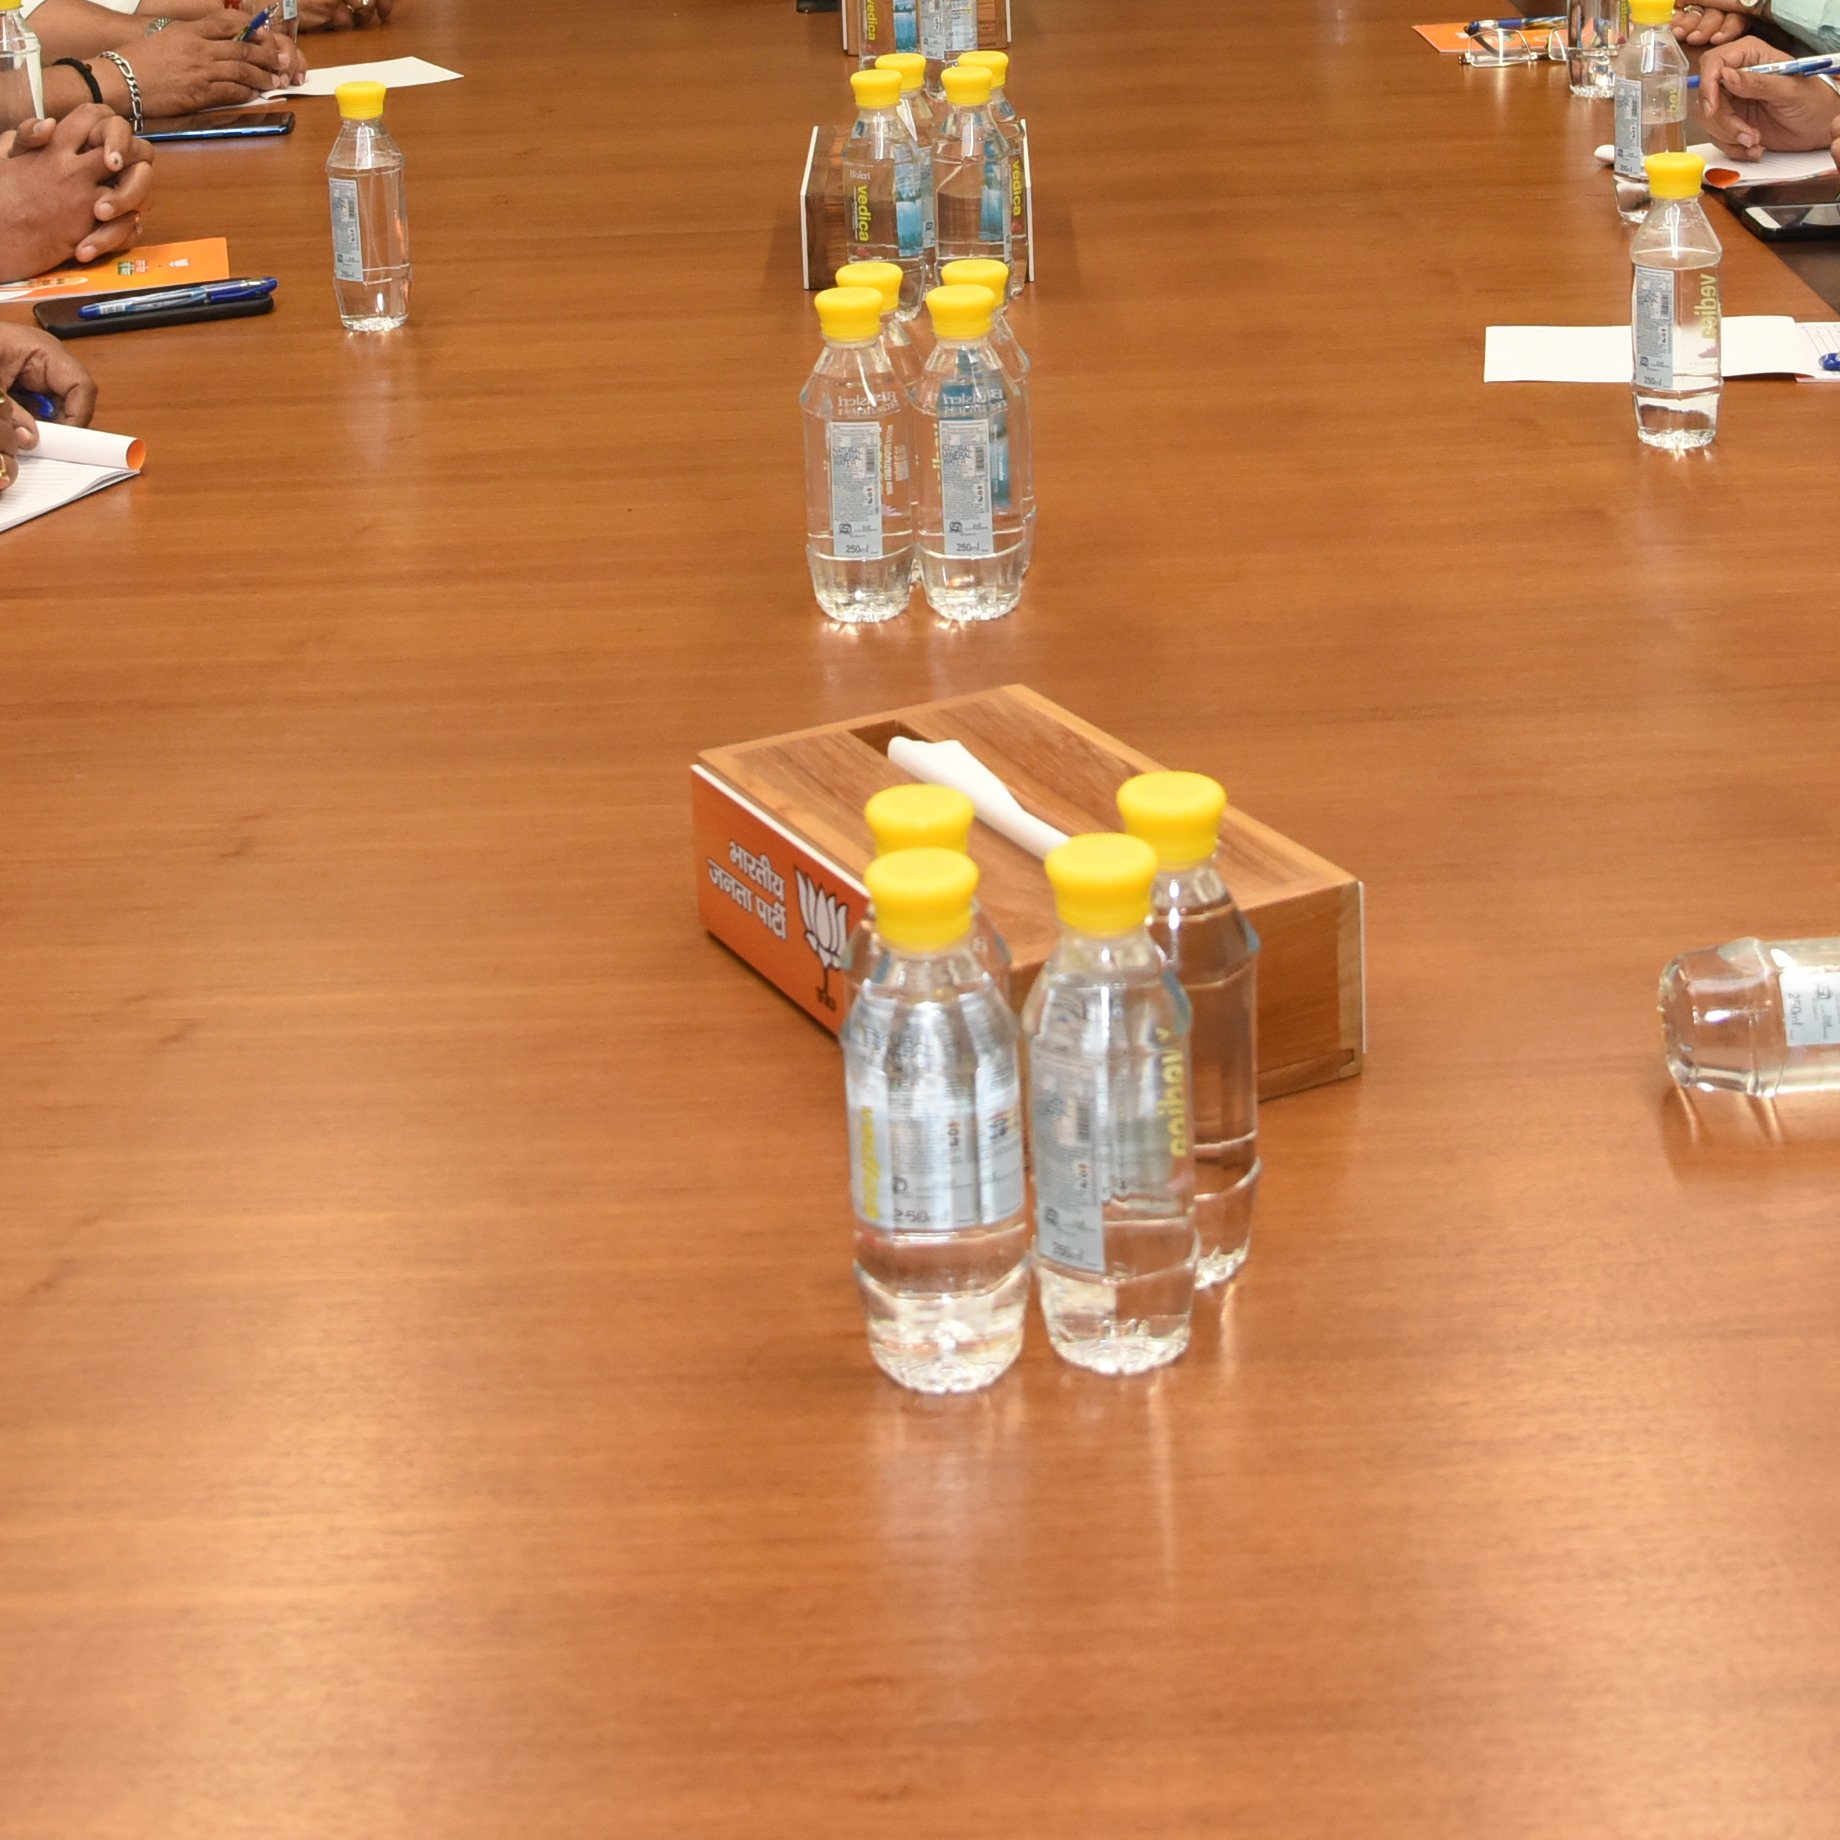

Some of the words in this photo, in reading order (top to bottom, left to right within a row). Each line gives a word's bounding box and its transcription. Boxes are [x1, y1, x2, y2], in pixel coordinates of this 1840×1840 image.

[1012, 159, 1023, 217] vedica
[857, 185, 871, 242] vedica
[832, 446, 863, 455] NATURAL
[942, 444, 973, 454] NATURAL
[832, 452, 863, 461] MINERAL
[942, 451, 973, 461] MINERAL
[845, 544, 869, 554] 250ml
[956, 543, 980, 553] 250ml
[728, 839, 785, 902] भारतीय
[707, 858, 753, 913] जनता
[755, 896, 787, 940] पार्टी
